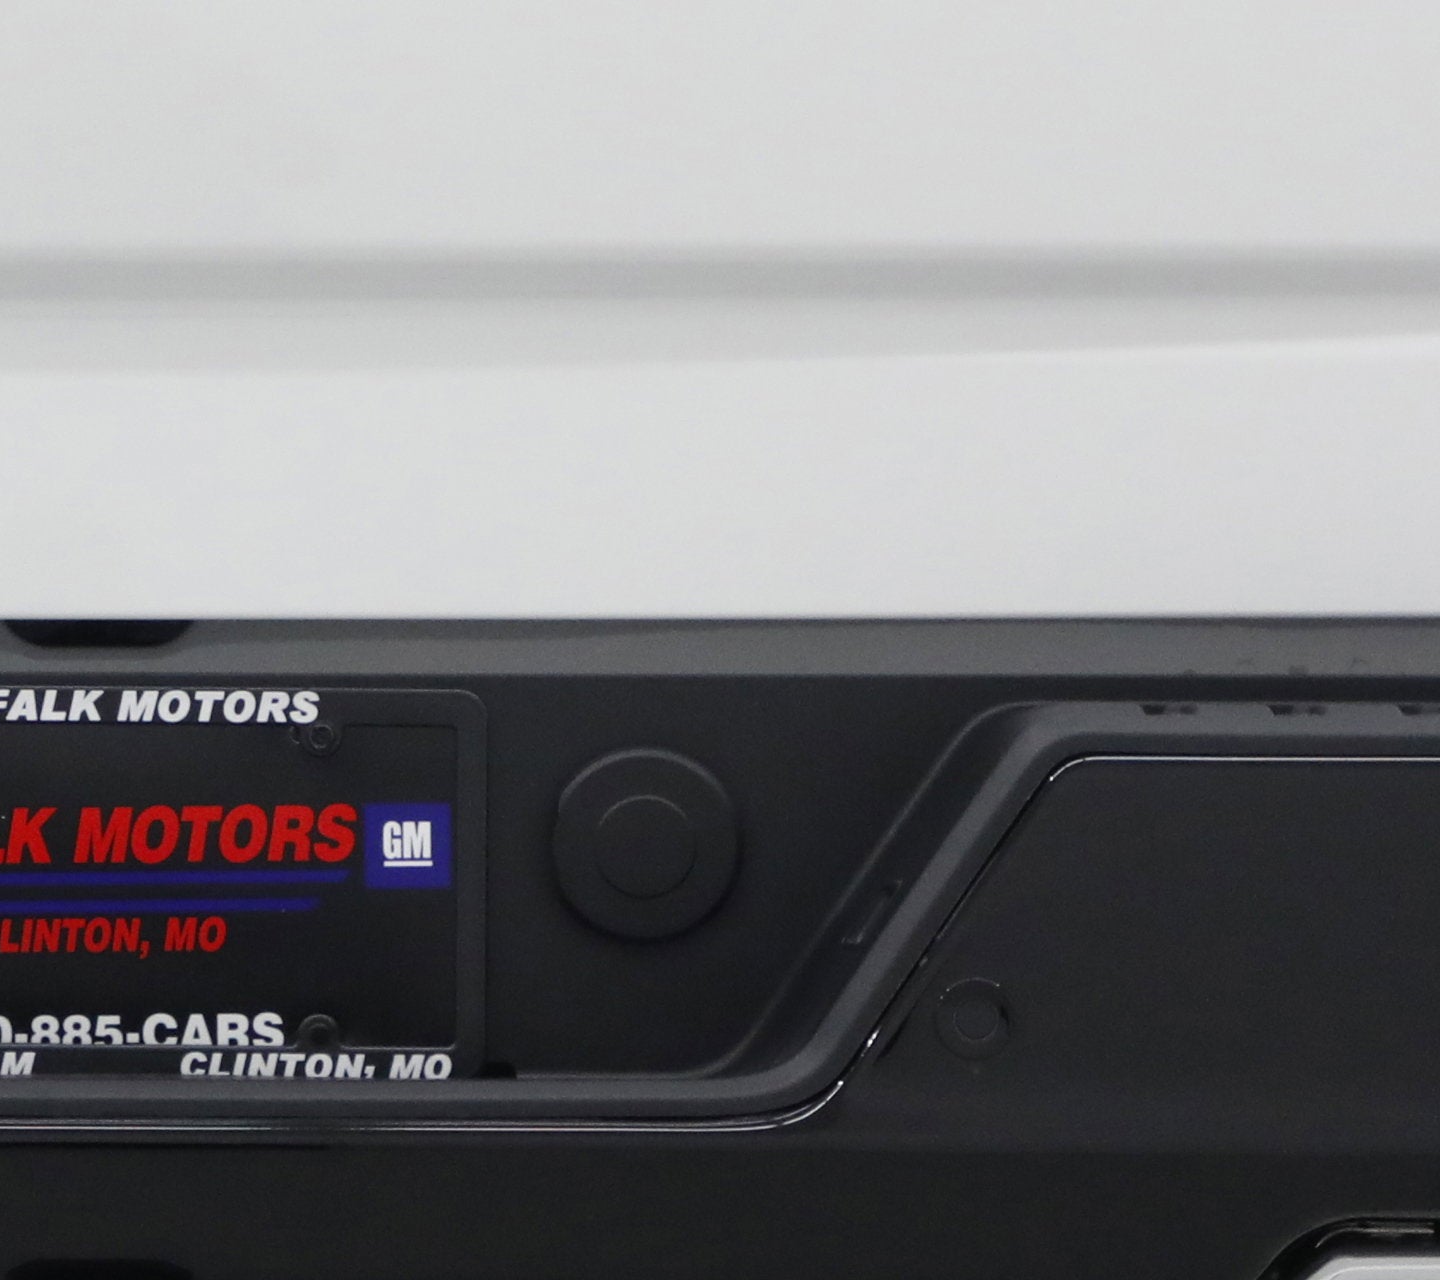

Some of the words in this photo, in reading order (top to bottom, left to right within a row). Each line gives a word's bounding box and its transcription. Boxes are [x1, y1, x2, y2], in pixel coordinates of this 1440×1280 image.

[117, 689, 321, 725] MOTORS
[74, 803, 358, 864] MOTORS
[381, 820, 434, 862] GM
[163, 915, 227, 955] MO
[390, 1053, 453, 1082] MO
